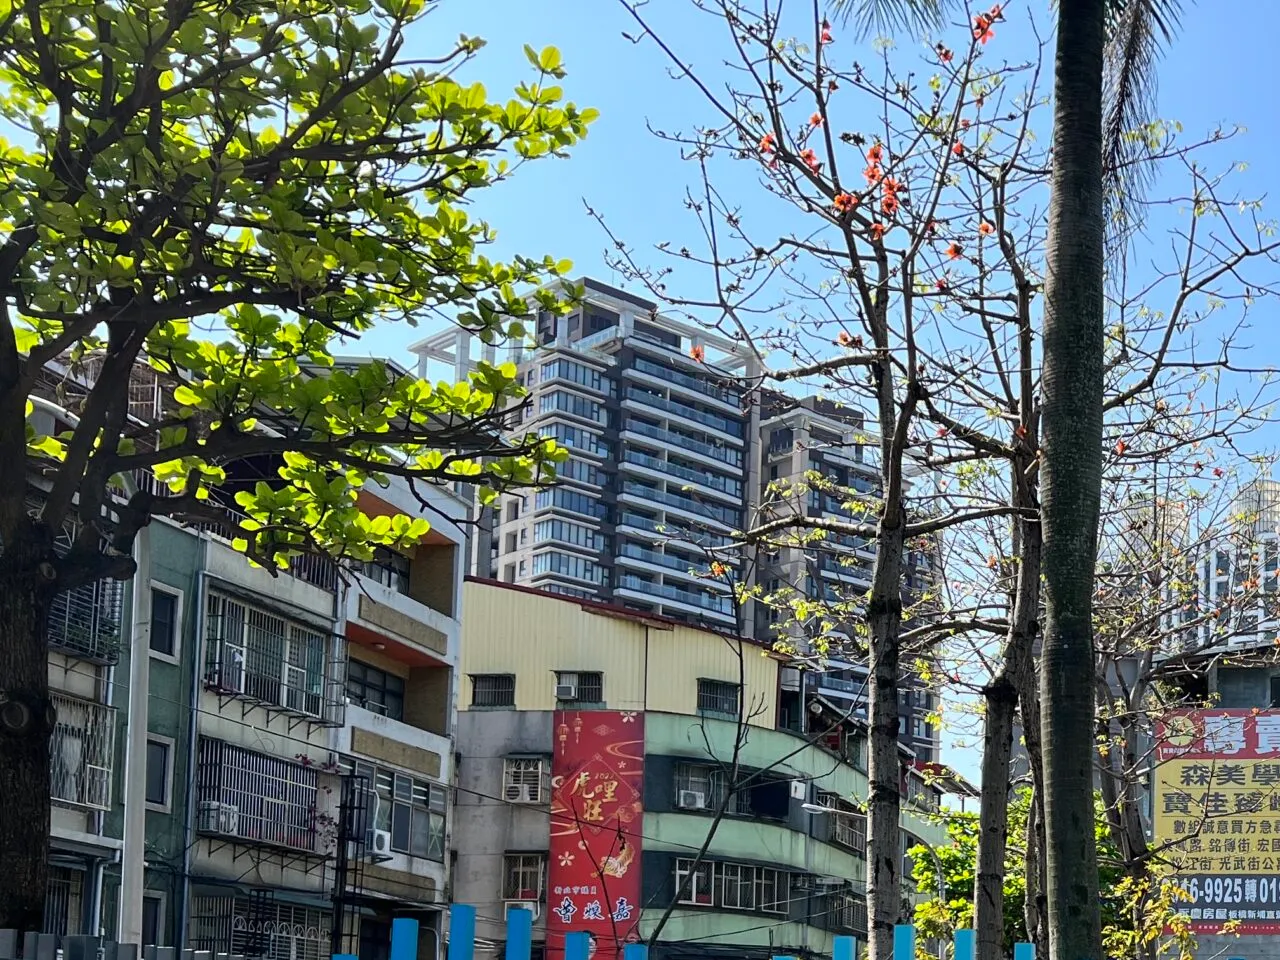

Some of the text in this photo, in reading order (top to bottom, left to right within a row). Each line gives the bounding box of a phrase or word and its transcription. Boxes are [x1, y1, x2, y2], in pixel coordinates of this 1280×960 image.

[569, 771, 619, 803] 虎哩
[1180, 764, 1280, 786] 森美學
